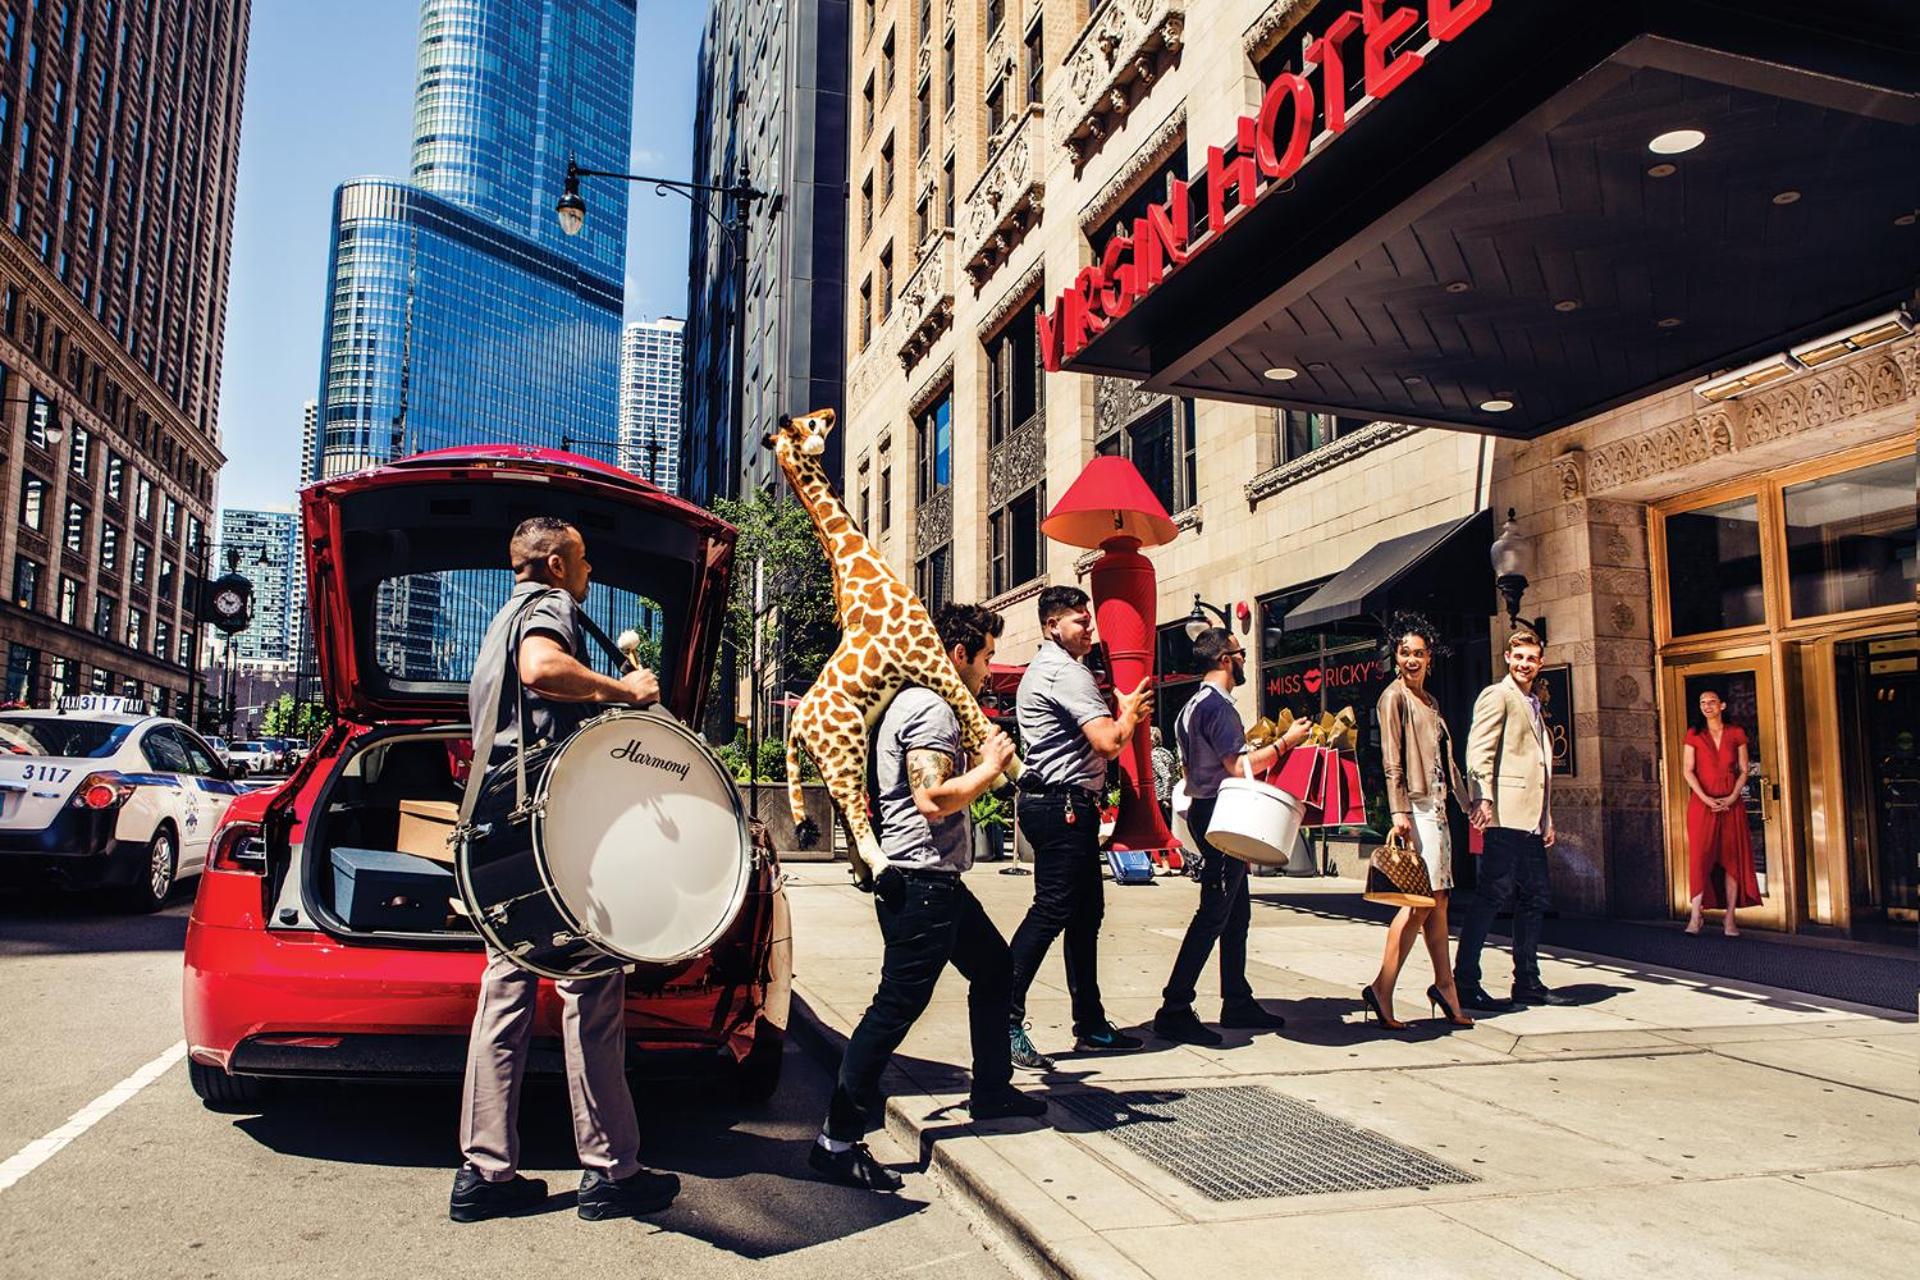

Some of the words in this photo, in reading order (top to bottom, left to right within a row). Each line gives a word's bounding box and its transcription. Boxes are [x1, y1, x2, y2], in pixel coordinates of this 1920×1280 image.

[1037, 179, 1189, 372] VIRGIN
[1267, 674, 1301, 697] MISS
[1325, 660, 1386, 689] RICKY'S
[81, 696, 120, 711] 3117
[123, 698, 144, 713] TAXI
[22, 764, 72, 783] 3117
[610, 738, 691, 782] Harmony
